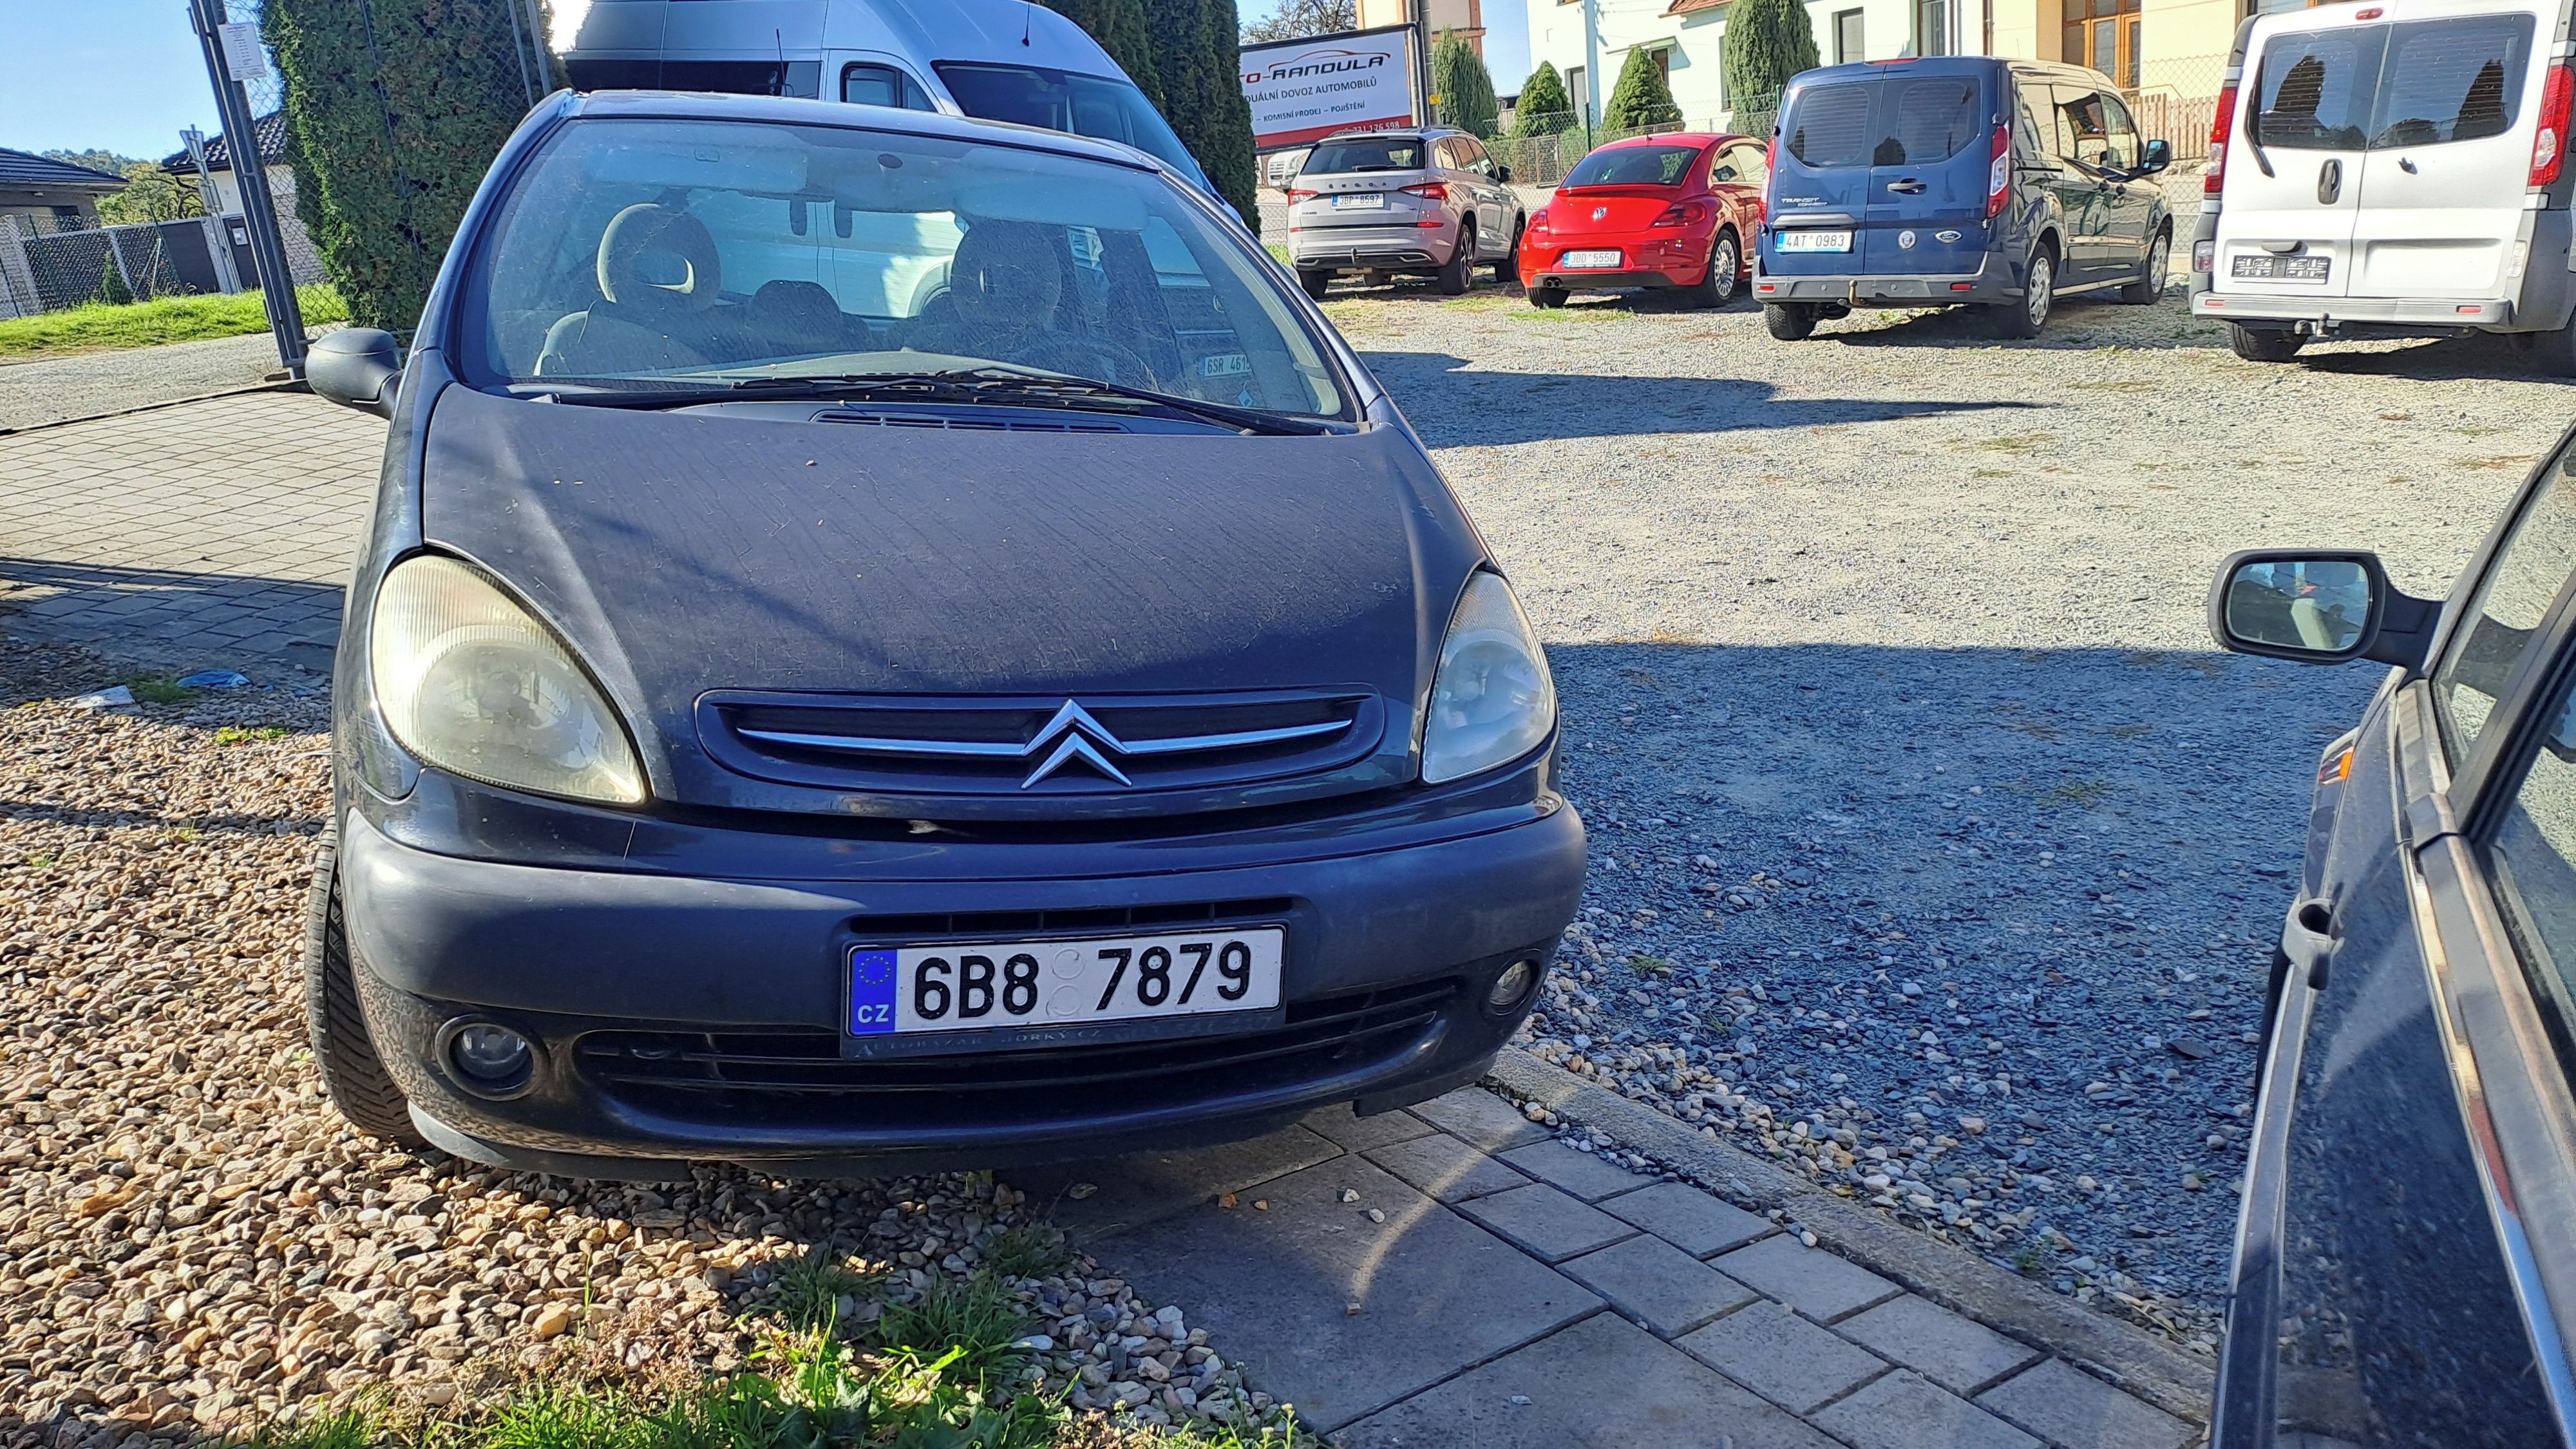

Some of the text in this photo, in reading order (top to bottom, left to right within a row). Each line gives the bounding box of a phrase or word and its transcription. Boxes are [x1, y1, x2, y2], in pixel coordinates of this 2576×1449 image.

[1282, 86, 1313, 99] DOVOZ
[1315, 76, 1377, 94] AUTOMOBILŮ
[1264, 109, 1294, 122] KOMISNÍ
[1295, 108, 1321, 118] PRODEJ
[1786, 234, 1844, 247] 4AT 0983
[1593, 252, 1616, 263] 5550
[1208, 357, 1224, 374] 6SR
[914, 940, 1252, 1021] 6B8 7879
[857, 1003, 890, 1024] CZ
